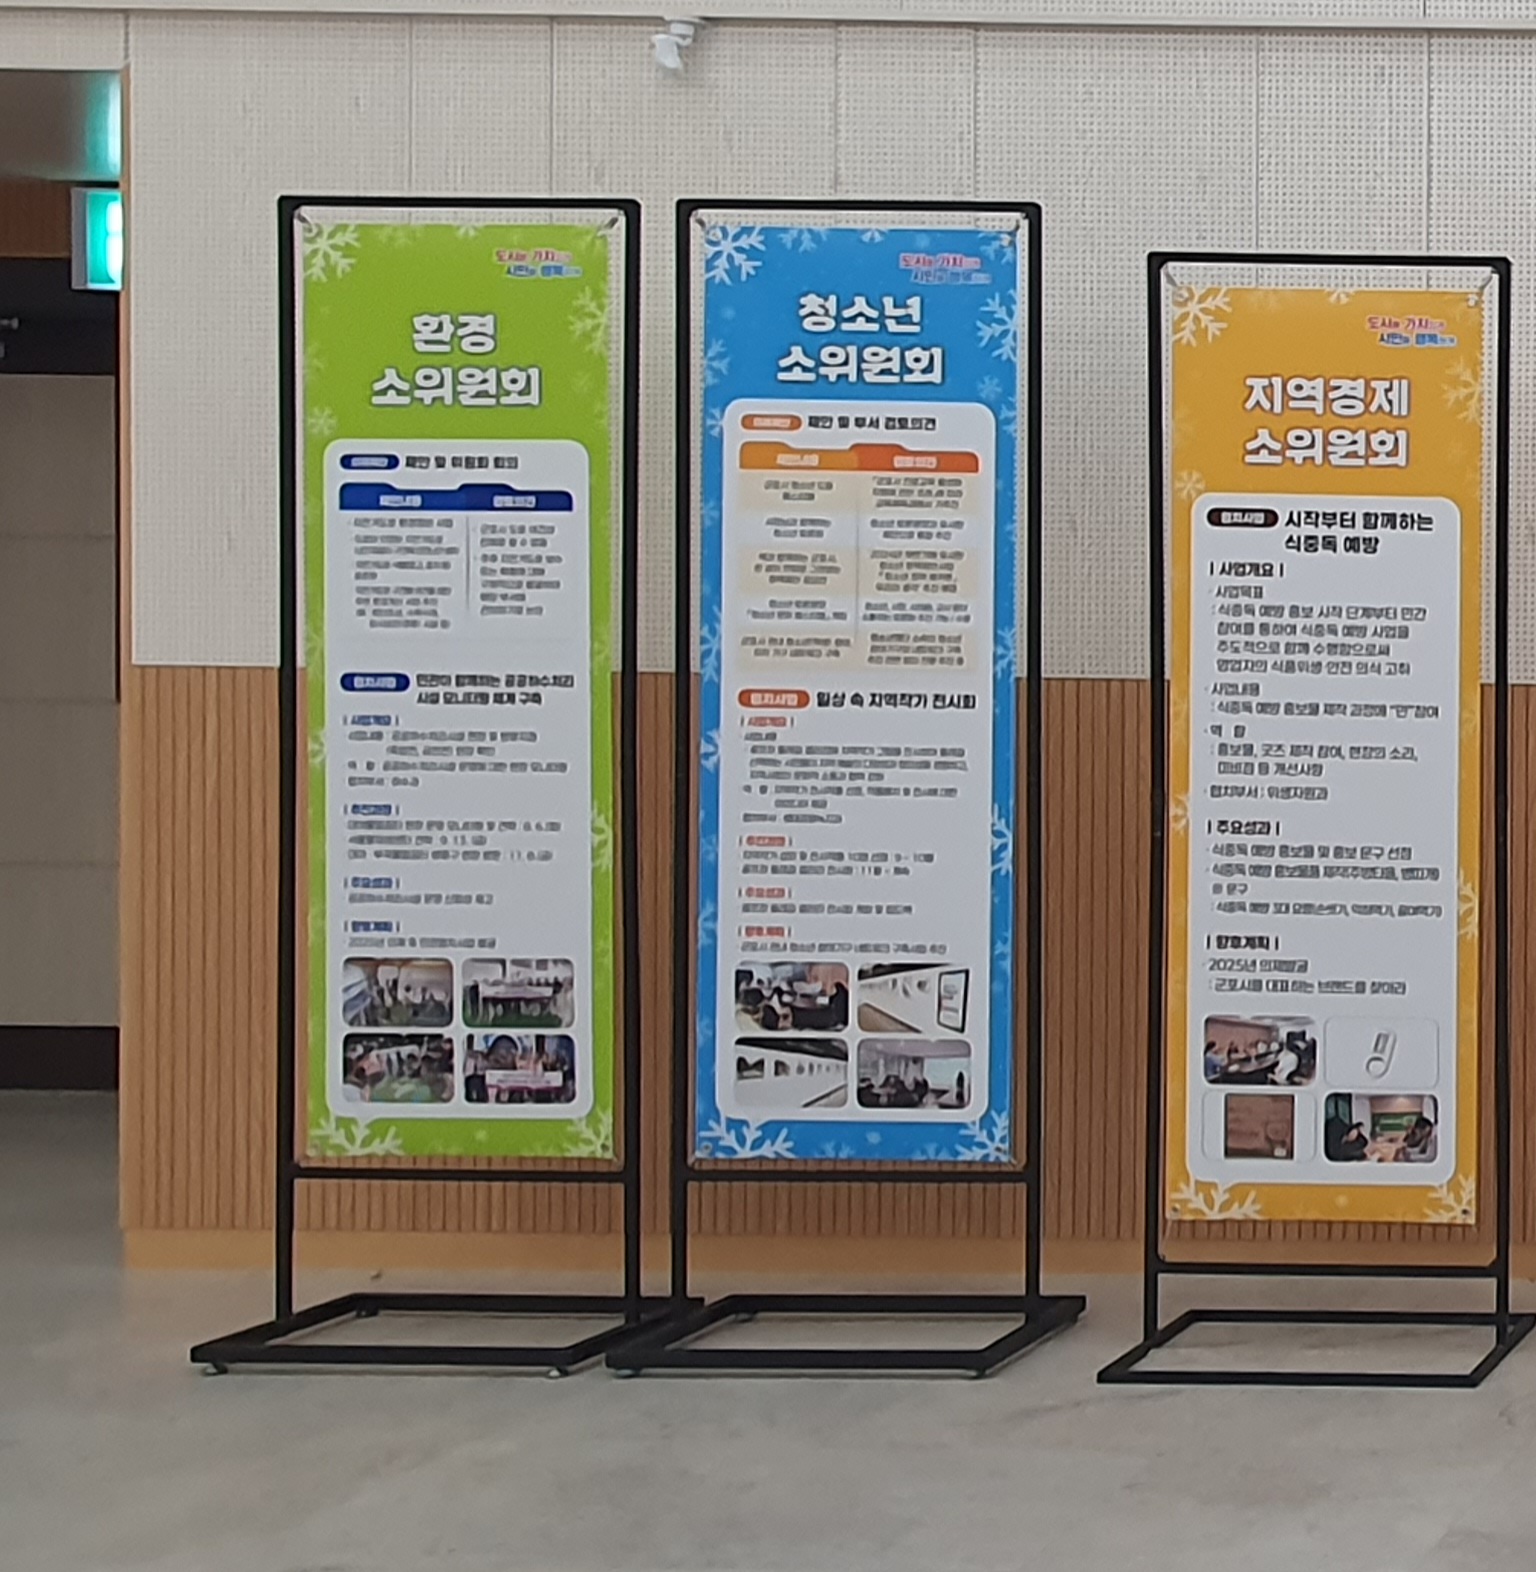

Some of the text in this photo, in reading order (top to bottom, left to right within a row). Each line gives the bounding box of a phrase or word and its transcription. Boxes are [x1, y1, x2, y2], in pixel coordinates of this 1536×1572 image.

[412, 313, 494, 353] 환경
[798, 294, 922, 334] 청소년
[776, 344, 942, 384] 소위원회
[371, 366, 540, 406] 소위원회
[1244, 377, 1409, 417] 지역경제
[1244, 428, 1408, 467] 소위원회
[1284, 510, 1434, 532] 시작부터 함께하는
[1284, 534, 1380, 555] 식중독 예방
[816, 691, 976, 710] 일상 속 지역작가 전시회
